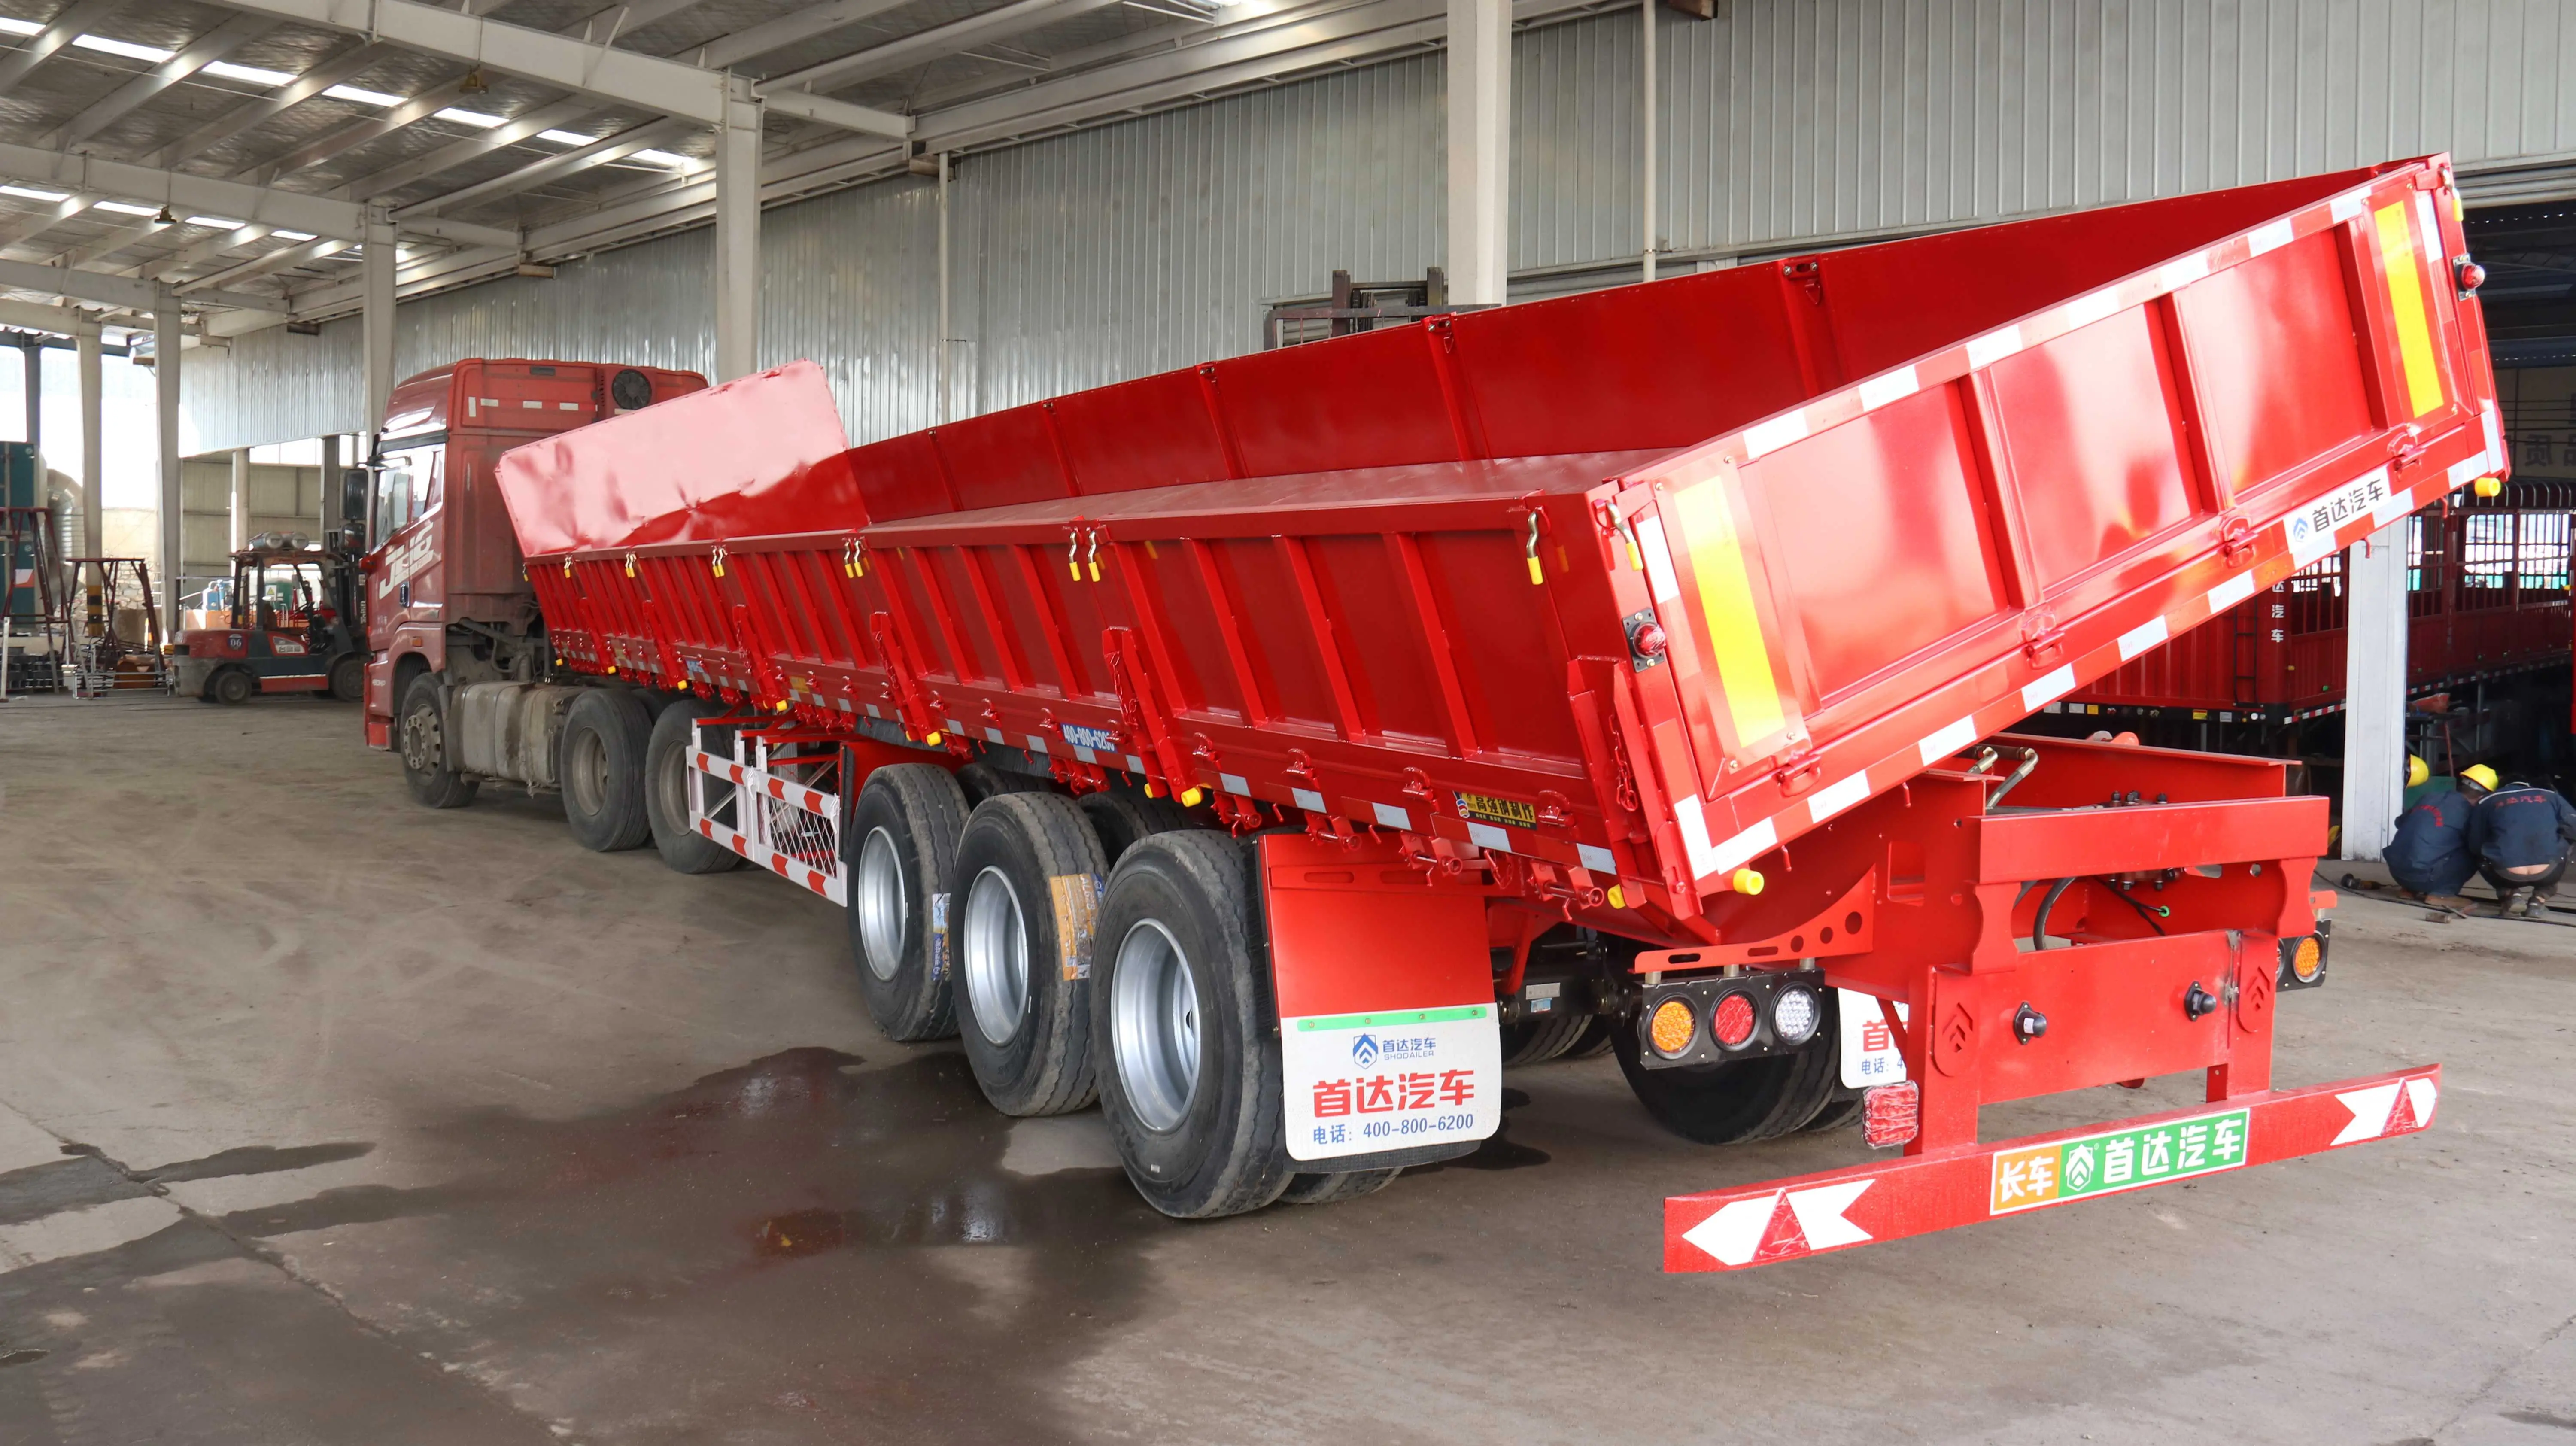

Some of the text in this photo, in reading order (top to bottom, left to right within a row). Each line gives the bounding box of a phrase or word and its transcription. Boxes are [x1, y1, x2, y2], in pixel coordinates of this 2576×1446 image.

[2312, 478, 2383, 533] 首达汽车
[1382, 1037, 1436, 1052] 首达汽车
[1384, 1050, 1434, 1060] SHODAILER
[1313, 1069, 1474, 1118] 首达汽车
[1363, 1114, 1474, 1138] 400-800-6200
[2000, 1119, 2242, 1202] 长车 首达汽车
